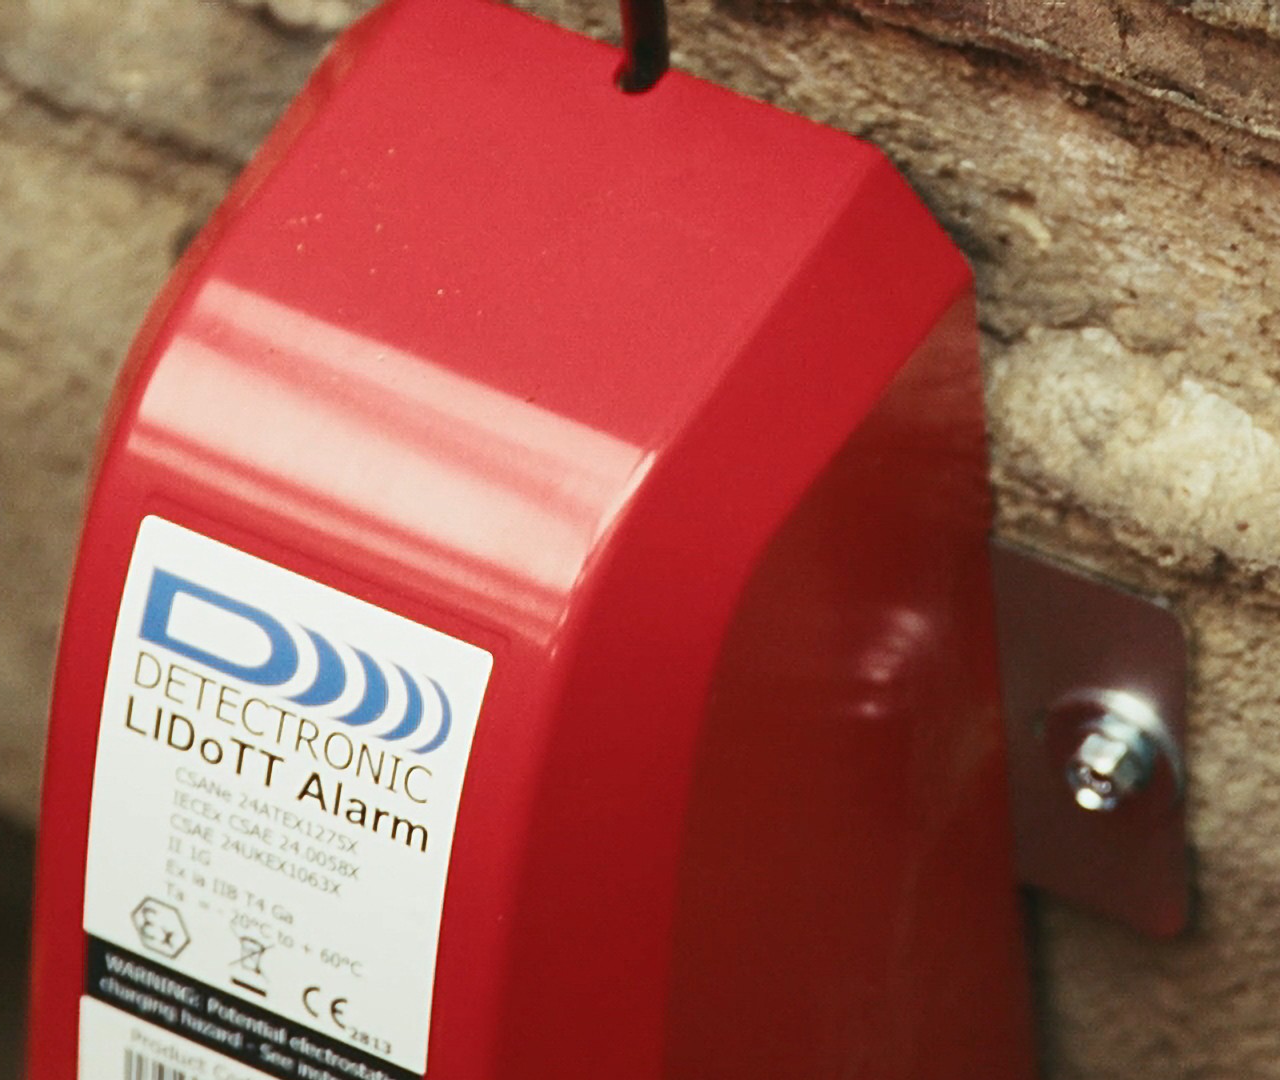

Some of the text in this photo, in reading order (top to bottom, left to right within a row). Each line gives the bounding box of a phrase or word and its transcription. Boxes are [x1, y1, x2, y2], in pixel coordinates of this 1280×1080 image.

[134, 651, 432, 804] DETECTRONIC
[125, 695, 429, 852] LIDoTT Alarm
[170, 814, 215, 844] CSAE
[173, 789, 221, 823] IECEx
[228, 813, 273, 845] CSAE
[99, 976, 179, 1024] charging
[181, 1004, 243, 1049] hazard
[259, 1043, 295, 1071] See
[104, 952, 200, 1006] WARNING:
[206, 997, 288, 1044] Potential
[130, 1027, 207, 1071] Product
[349, 1026, 393, 1054] 2813
